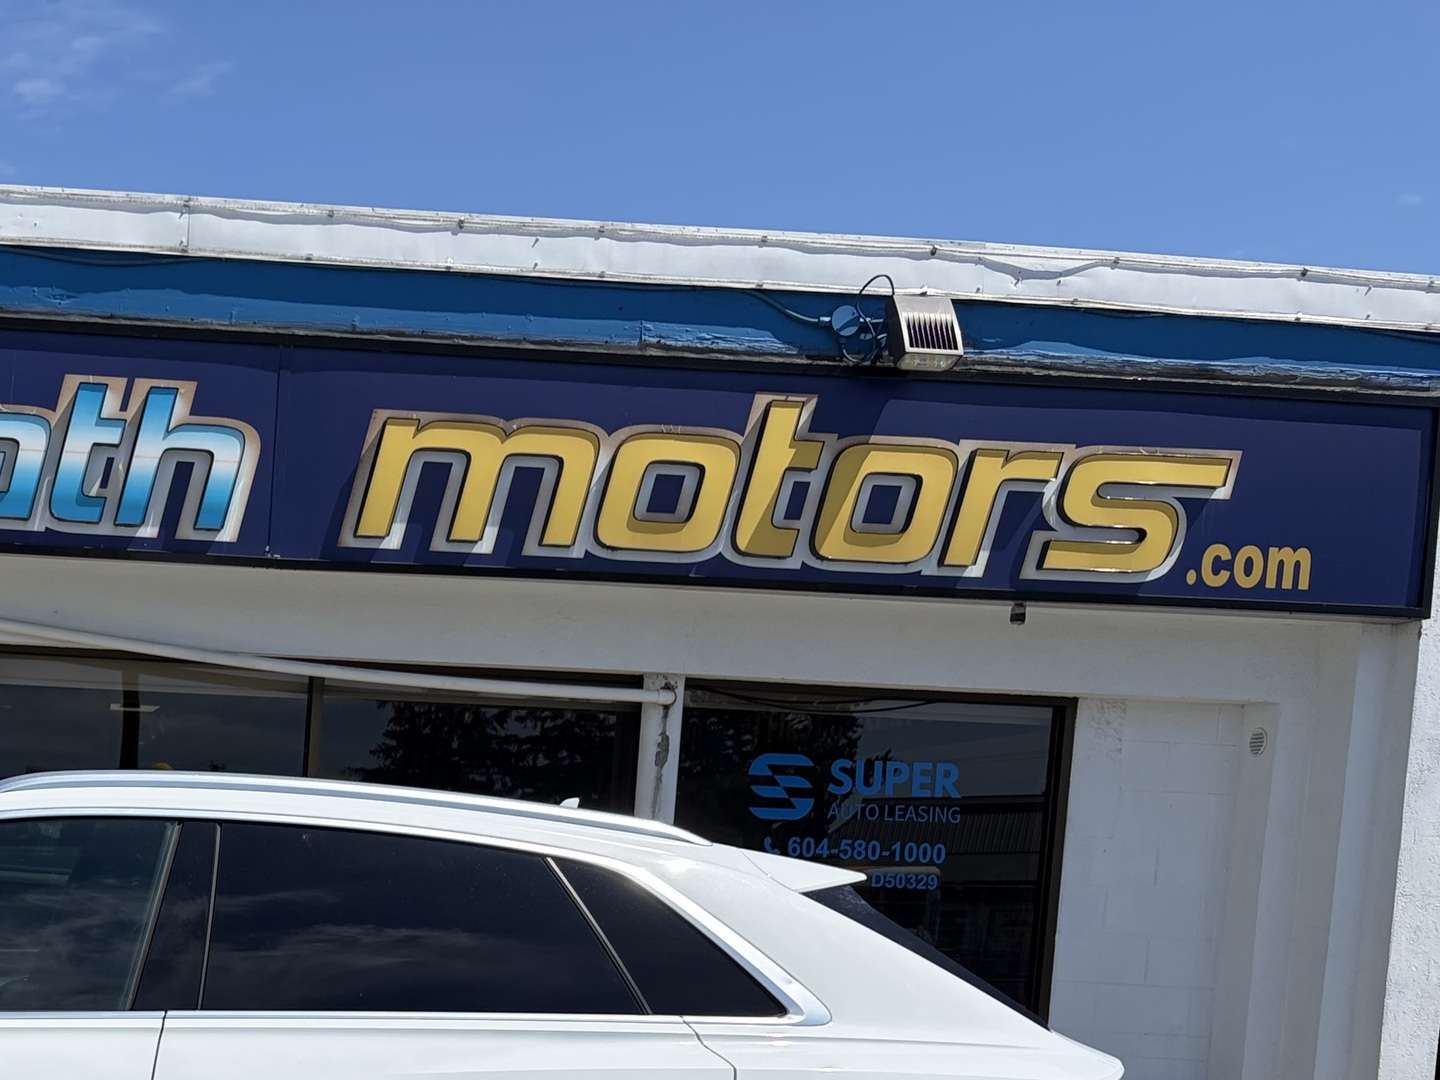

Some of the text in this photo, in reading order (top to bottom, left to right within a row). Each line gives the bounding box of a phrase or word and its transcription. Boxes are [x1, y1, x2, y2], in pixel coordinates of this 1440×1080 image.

[339, 393, 1242, 582] motors
[1187, 543, 1311, 590] .com
[827, 758, 961, 799] SUPER
[827, 803, 961, 824] AUTO LEASING
[787, 837, 946, 864] 604-580-1000
[871, 873, 939, 890] D50329
